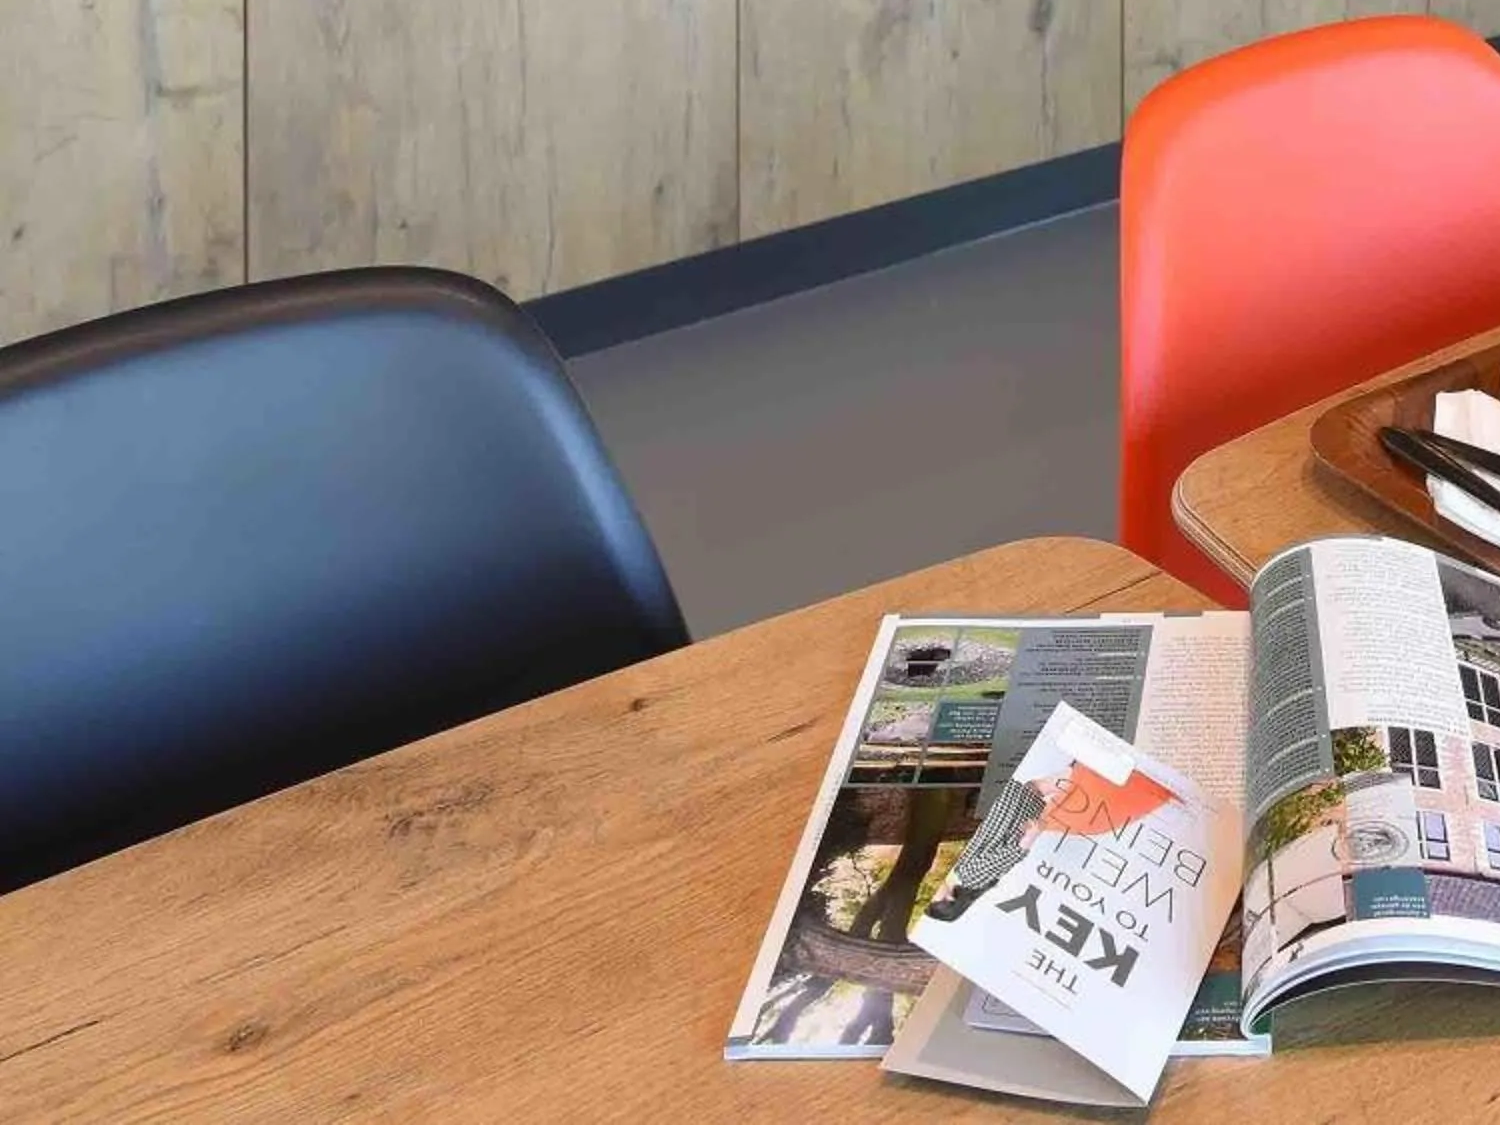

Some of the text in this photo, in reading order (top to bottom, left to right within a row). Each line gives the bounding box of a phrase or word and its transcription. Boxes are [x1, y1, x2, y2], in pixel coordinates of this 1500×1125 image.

[1050, 814, 1174, 924] WELL
[1054, 778, 1208, 888] BEING
[995, 883, 1141, 988] KEY
[1036, 860, 1150, 943] TO YOUR
[1025, 948, 1080, 995] THE
